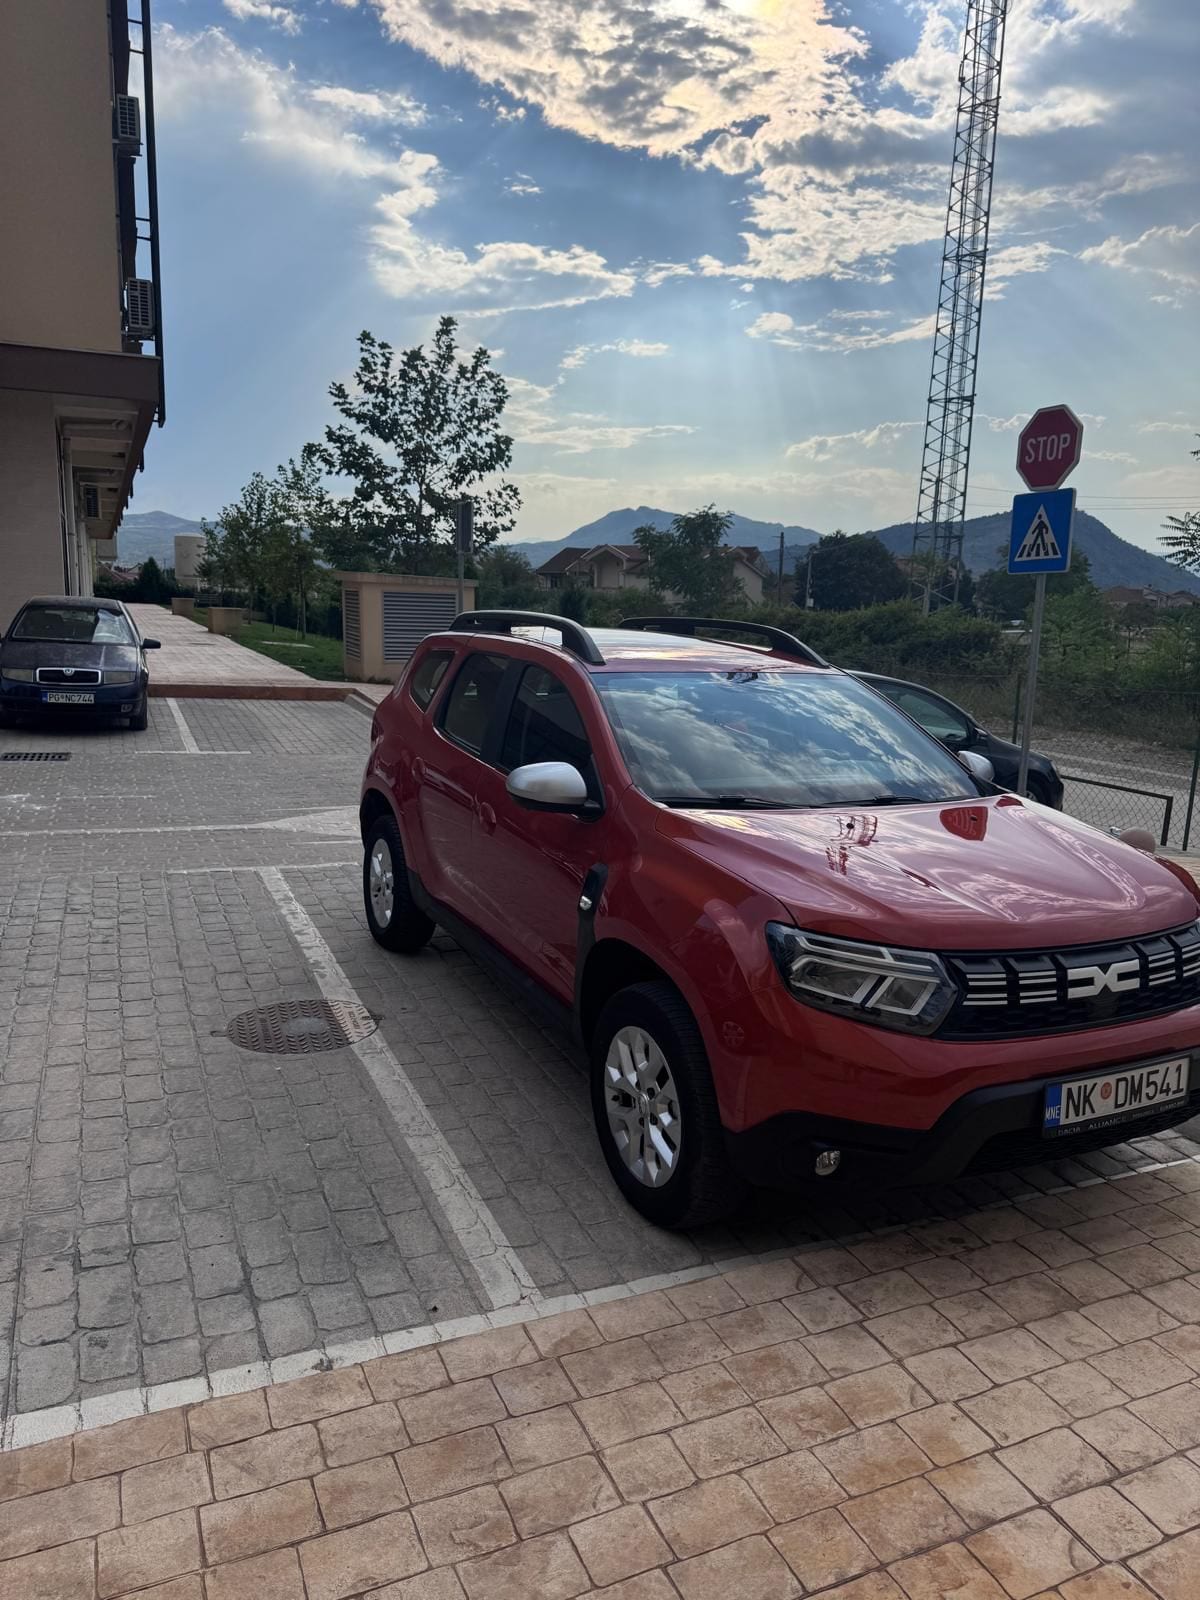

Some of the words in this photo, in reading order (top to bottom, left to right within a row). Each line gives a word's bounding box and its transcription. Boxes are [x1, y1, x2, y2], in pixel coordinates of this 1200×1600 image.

[1024, 433, 1071, 464] STOP
[48, 693, 60, 702] PG
[1065, 1082, 1097, 1119] NK
[1114, 1063, 1184, 1109] DM541
[1045, 1105, 1060, 1120] MNE
